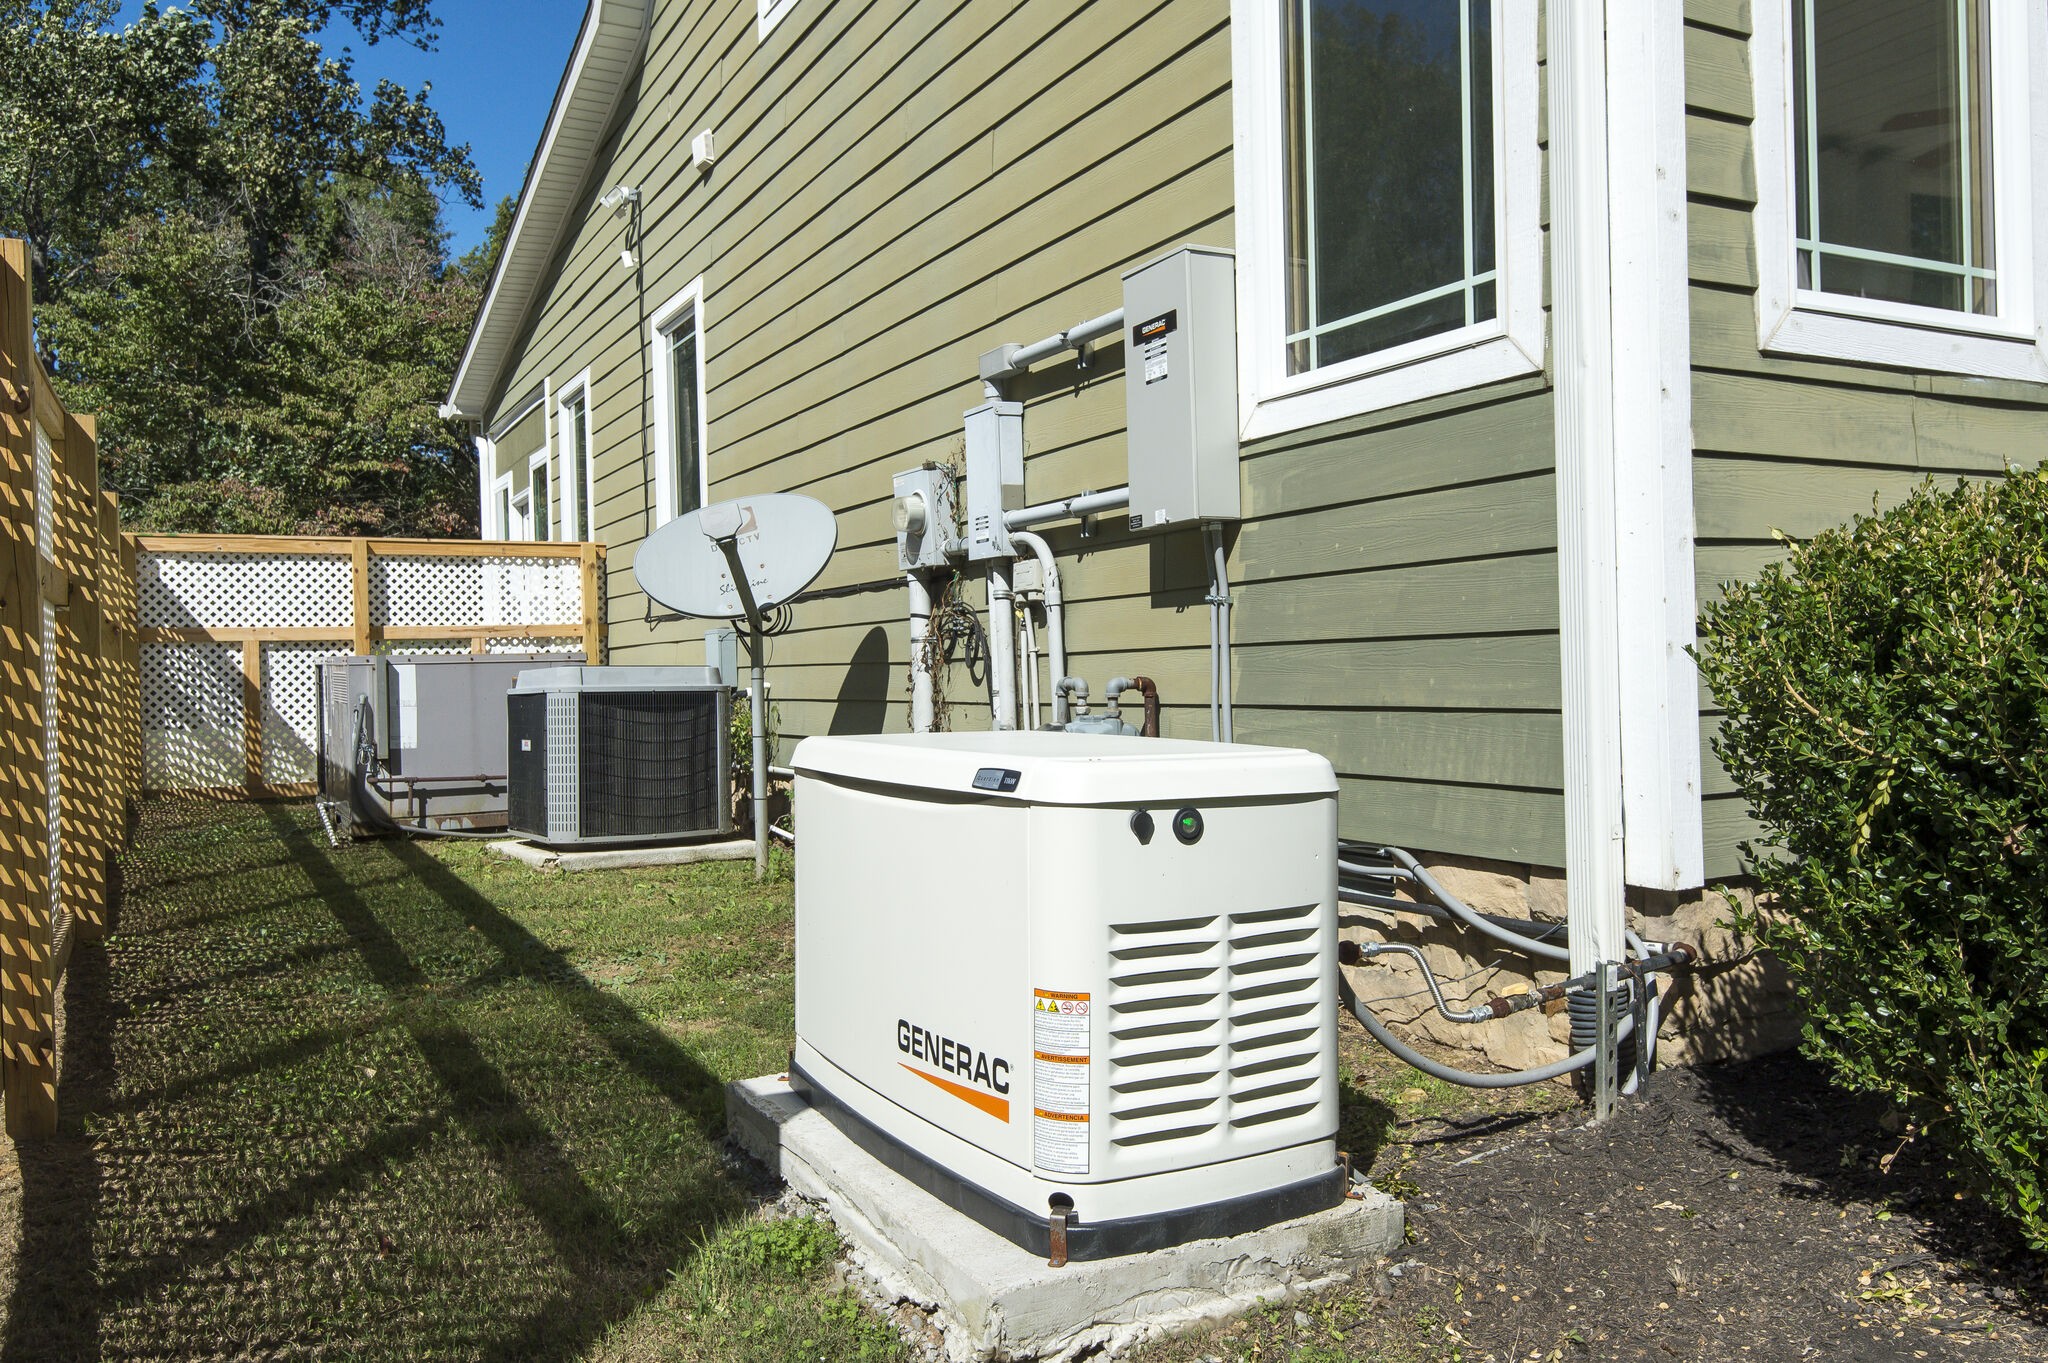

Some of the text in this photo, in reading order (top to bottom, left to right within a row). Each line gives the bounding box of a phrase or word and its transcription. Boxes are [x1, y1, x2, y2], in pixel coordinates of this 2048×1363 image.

[1142, 319, 1166, 334] GENERAC
[710, 532, 760, 553] DCTV
[719, 578, 769, 596] Sliine
[897, 1018, 1010, 1095] GENERAC
[1041, 1054, 1088, 1063] AVERTISSEMENT
[1045, 1112, 1085, 1121] ADVERTENCIA
